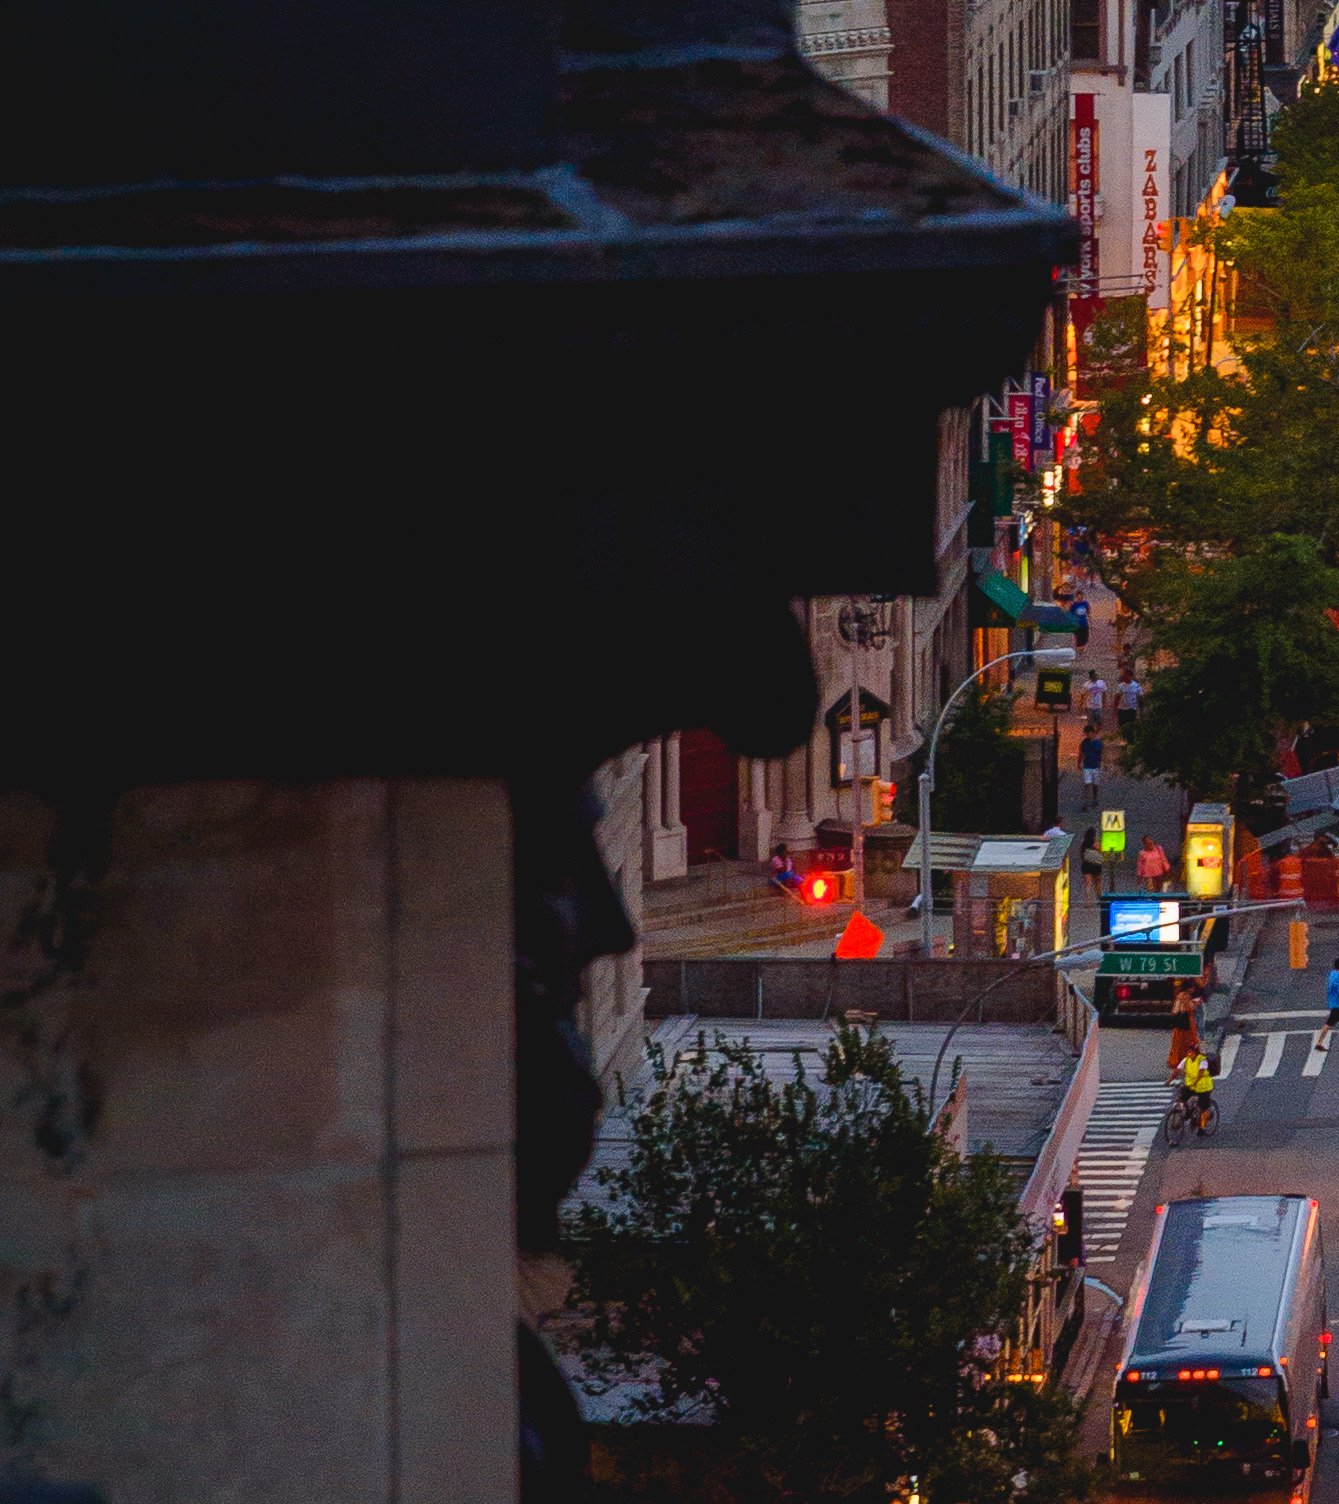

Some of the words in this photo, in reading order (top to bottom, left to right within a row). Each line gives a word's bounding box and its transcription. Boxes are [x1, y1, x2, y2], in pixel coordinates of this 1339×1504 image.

[1077, 127, 1091, 175] clubs
[1077, 179, 1092, 235] sports
[1120, 958, 1132, 971] W
[1140, 957, 1156, 971] 79
